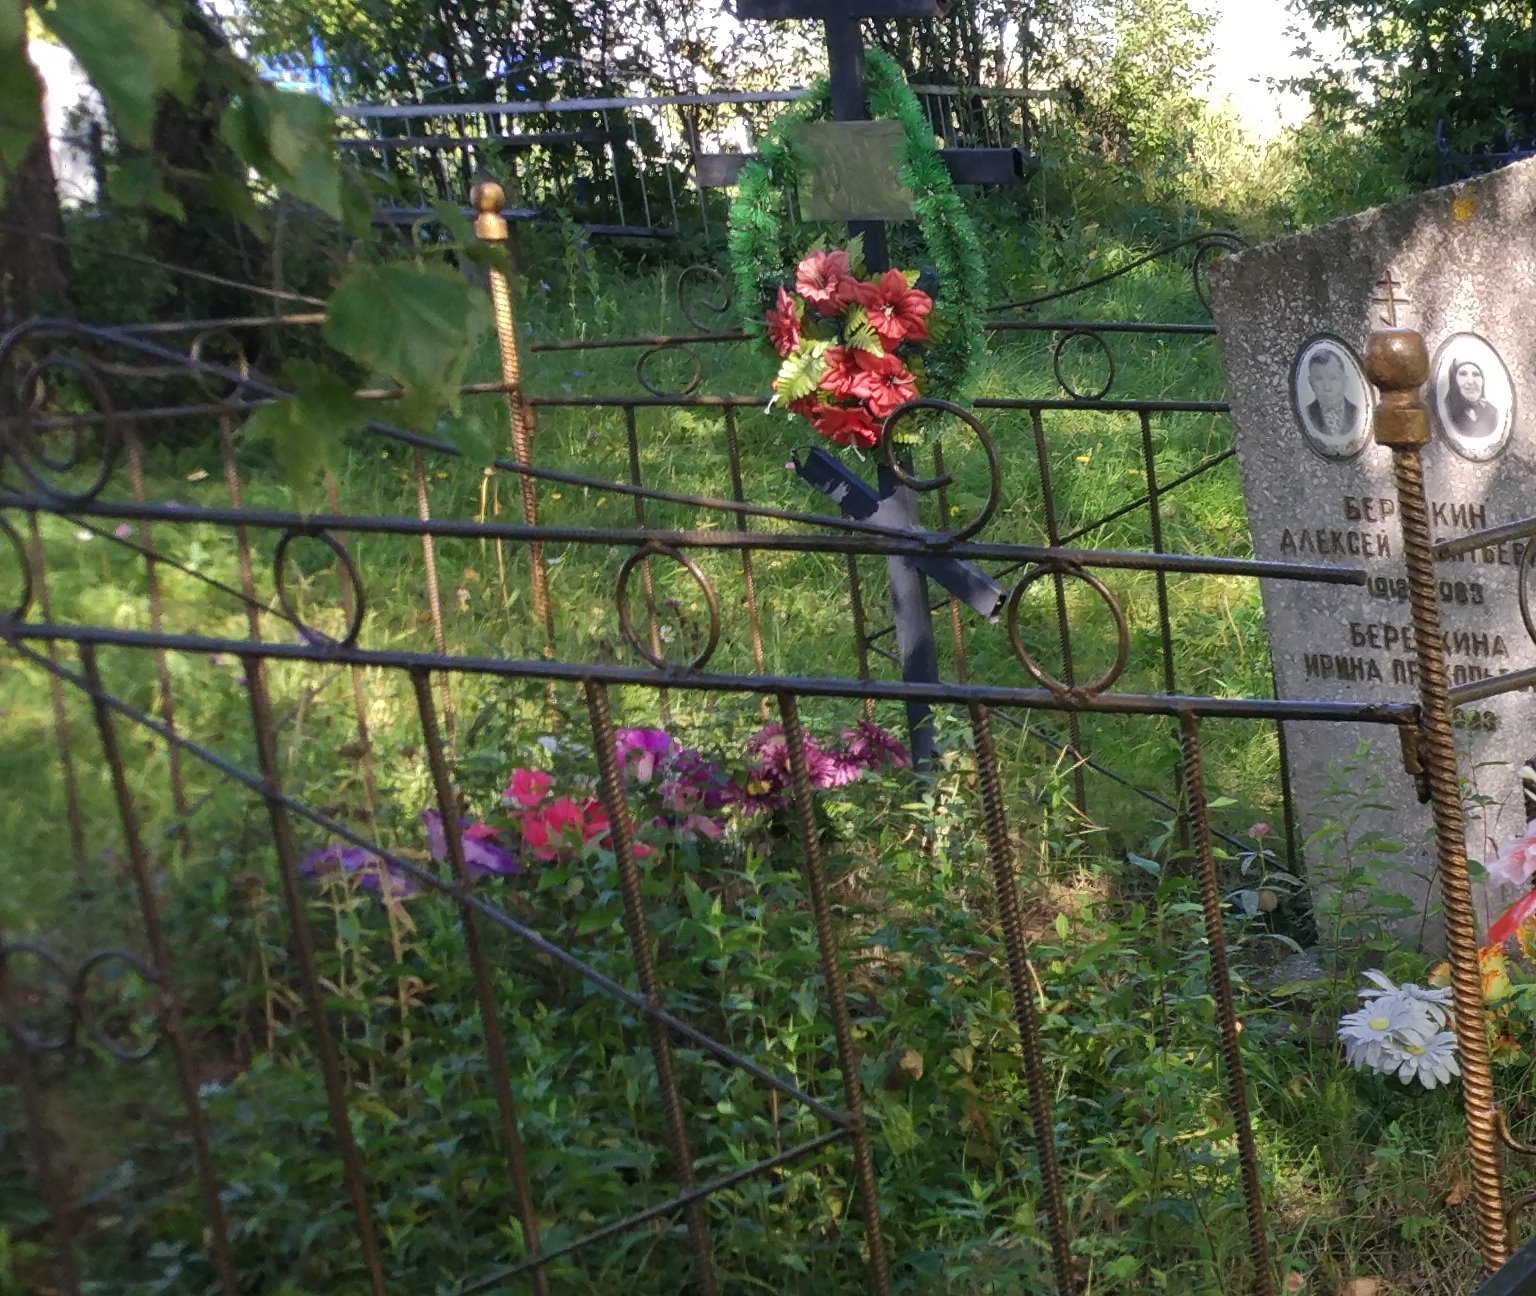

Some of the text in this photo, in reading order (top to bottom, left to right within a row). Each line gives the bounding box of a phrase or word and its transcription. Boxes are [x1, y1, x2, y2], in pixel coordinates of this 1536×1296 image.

[1343, 496, 1487, 530] БЕРКИН
[1280, 528, 1391, 558] АЛЕКСЕЙ
[1303, 652, 1383, 684] ИРИНА
